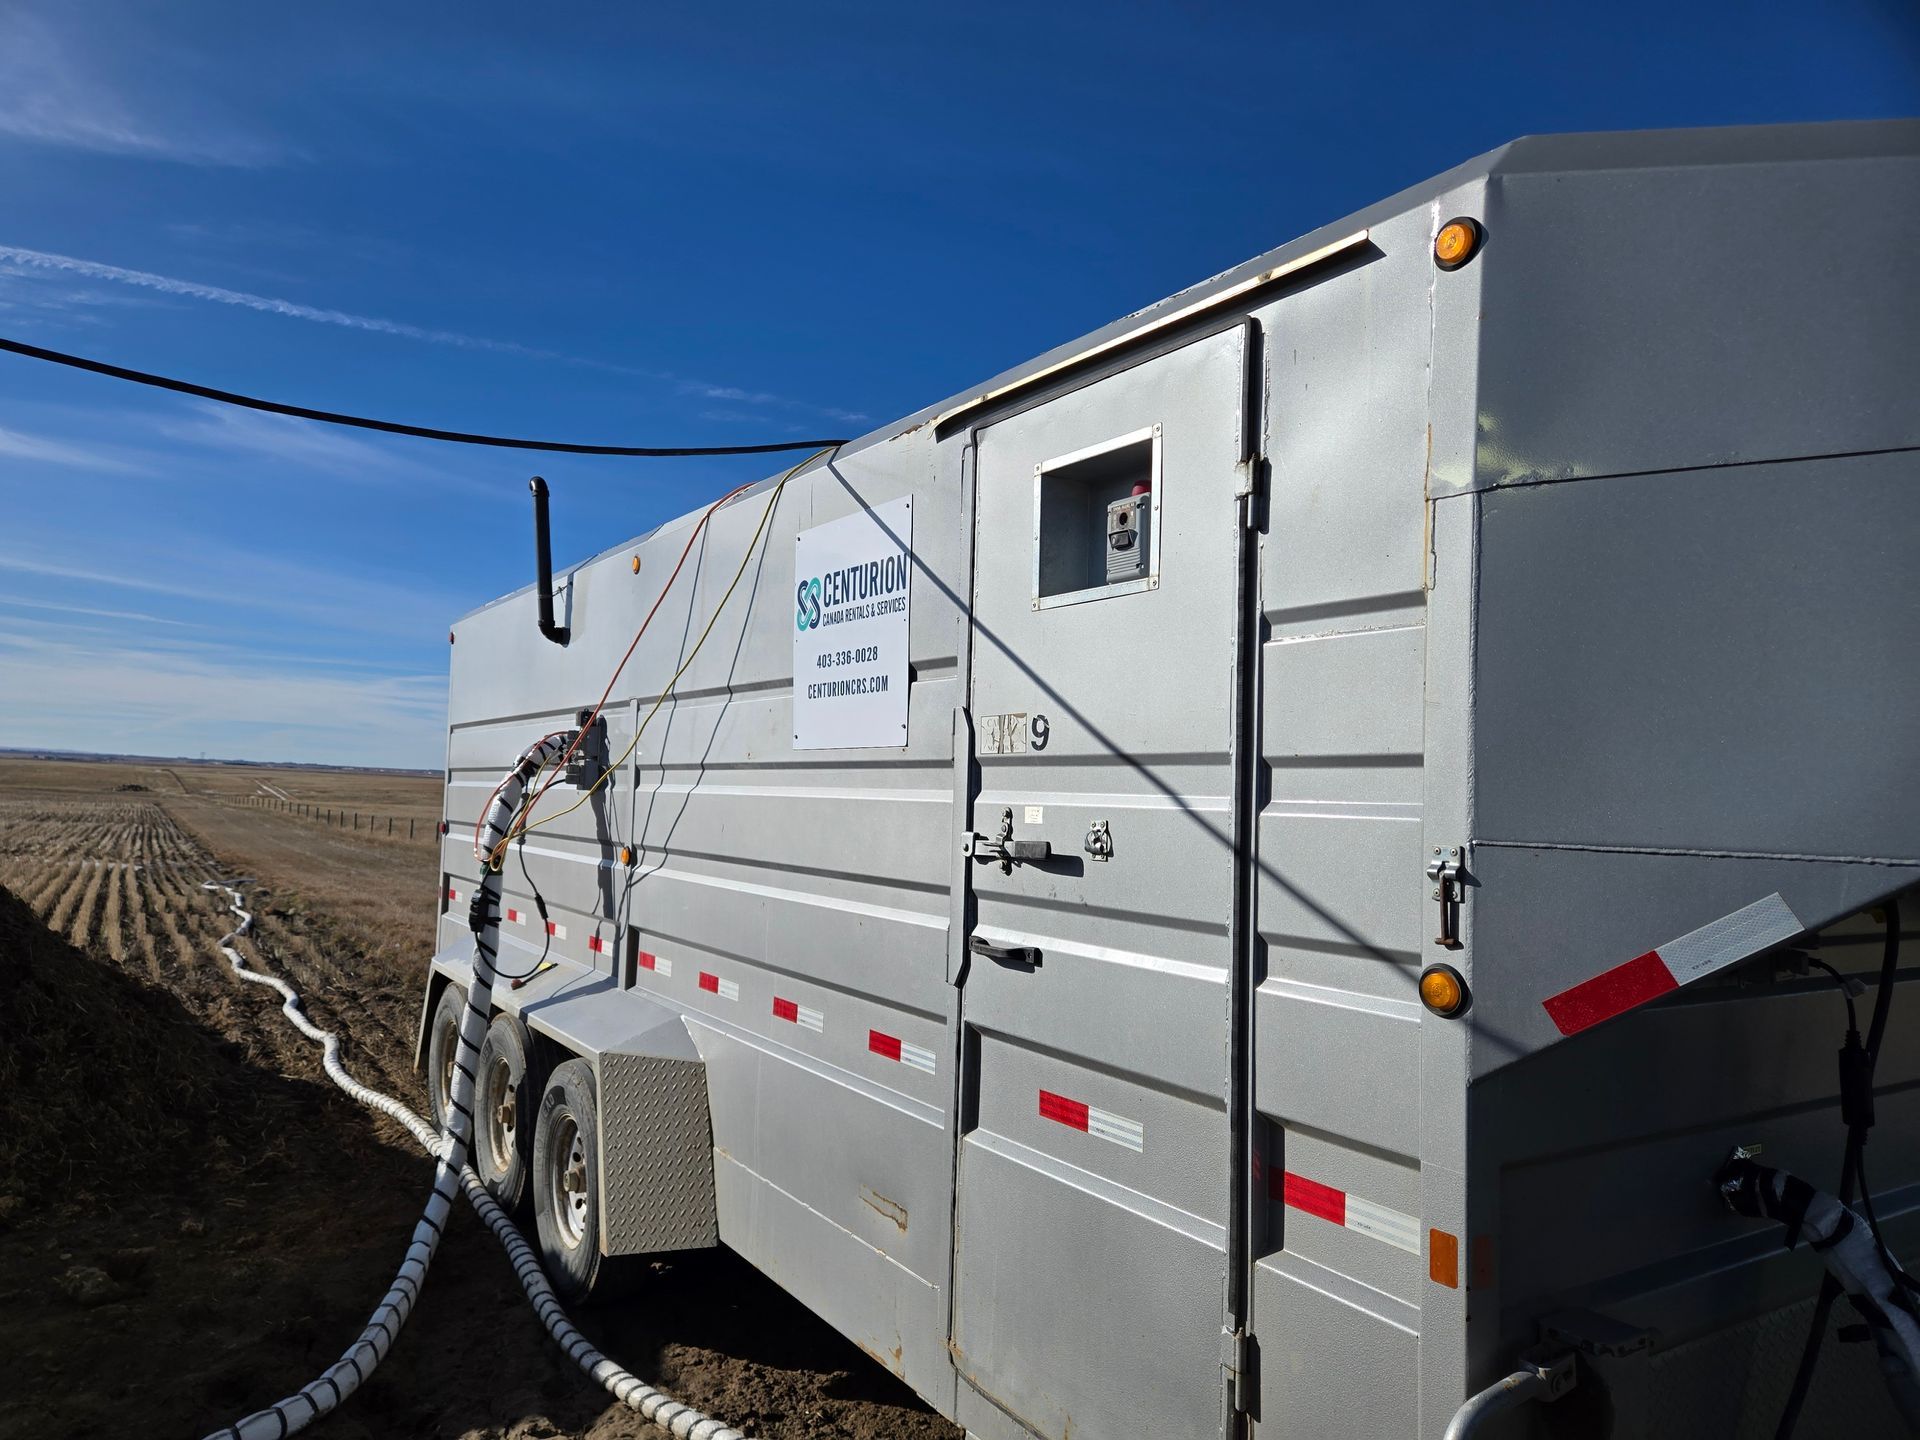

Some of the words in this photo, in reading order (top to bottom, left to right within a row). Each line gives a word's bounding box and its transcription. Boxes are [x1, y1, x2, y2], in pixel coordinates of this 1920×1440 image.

[823, 552, 907, 608] CENTURION
[822, 609, 845, 627] CANADA
[845, 603, 870, 622] RENTALS
[870, 602, 876, 618] &
[876, 596, 906, 616] SERVICES
[816, 645, 878, 669] 403-336-0028
[807, 674, 889, 700] CENTURIONCRS.COM
[1030, 714, 1050, 751] 9
